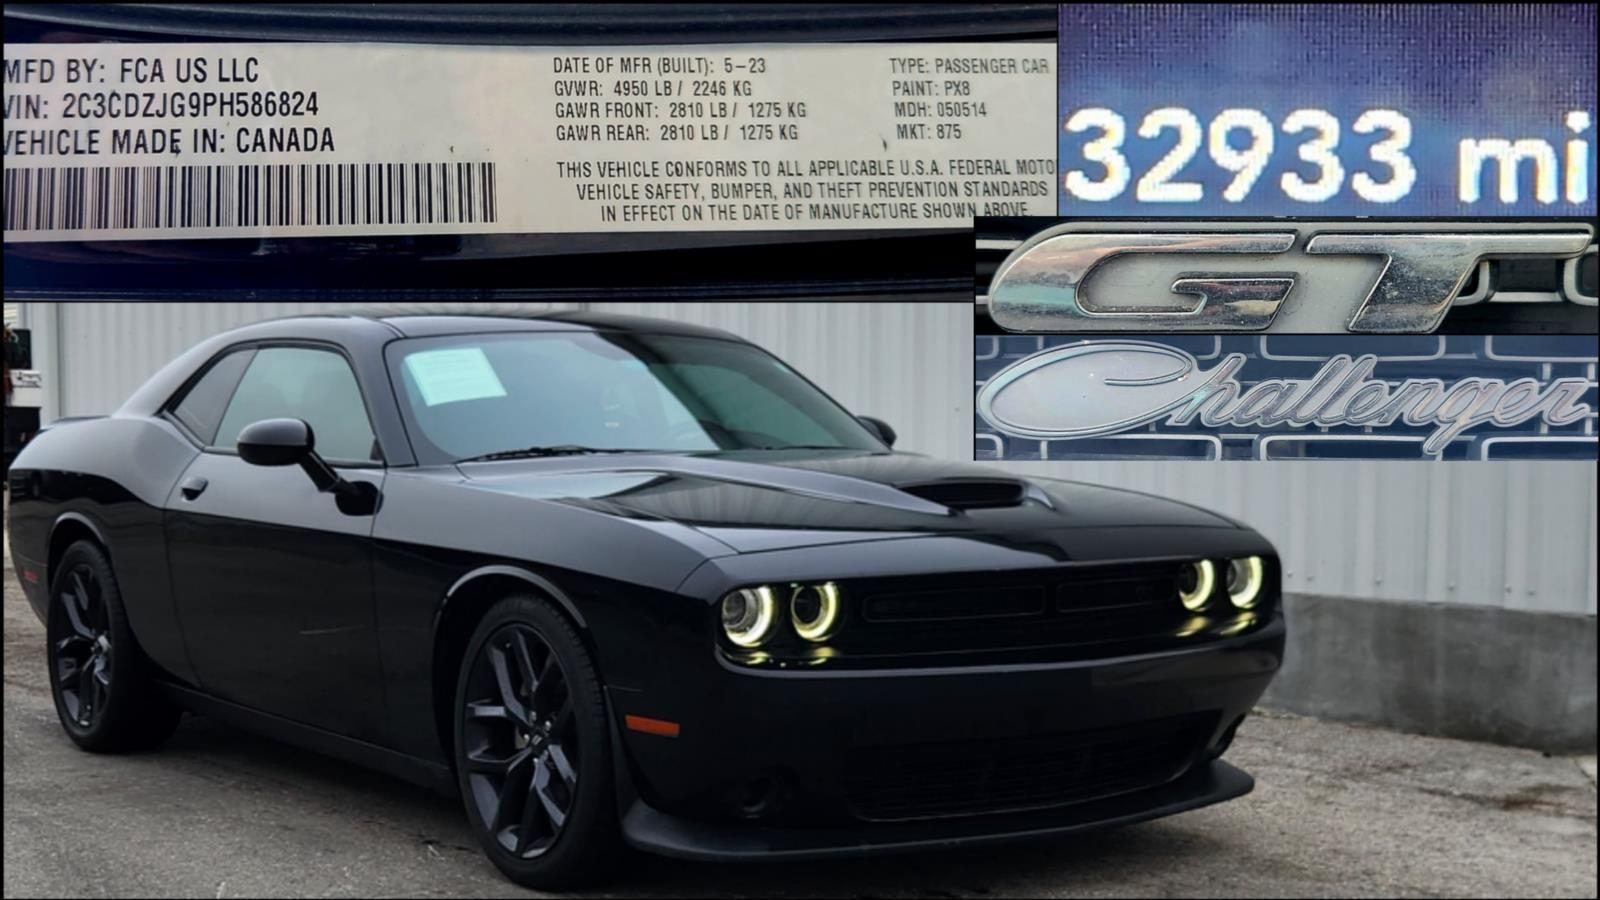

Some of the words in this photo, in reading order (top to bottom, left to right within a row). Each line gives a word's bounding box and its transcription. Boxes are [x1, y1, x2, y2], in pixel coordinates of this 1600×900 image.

[4, 58, 55, 84] MFD
[66, 57, 105, 84] BY:
[120, 57, 165, 84] FCA
[176, 57, 208, 84] US
[218, 56, 259, 83] LLC
[553, 56, 590, 74] DATE
[595, 56, 614, 74] OF
[620, 56, 652, 74] MFR
[657, 56, 715, 77] (BUILT):
[723, 57, 766, 74] 5-23
[888, 57, 930, 74] TYPE:
[934, 57, 1018, 74] PASSENGER
[1021, 58, 1049, 74] CAR
[554, 80, 603, 97] GVWR:
[613, 79, 649, 97] 4950
[654, 80, 673, 97] LB
[677, 79, 683, 97] /
[692, 80, 727, 97] 2246
[732, 80, 752, 97] KG
[892, 80, 939, 97] PAINT:
[943, 80, 971, 97] PX8
[4, 94, 49, 120] VIN:
[62, 90, 319, 119] 2C3CDZJG9PH586824
[555, 101, 600, 119] GAWR
[605, 101, 659, 119] FRONT:
[669, 101, 704, 119] 2810
[709, 101, 728, 118] LB
[731, 101, 738, 119] /
[747, 101, 783, 118] 1275
[787, 101, 807, 118] KG
[893, 101, 932, 118] MDH:
[936, 101, 988, 118] 050514
[4, 128, 101, 156] VEHICLE
[111, 128, 182, 156] MADE
[193, 128, 225, 154] IN:
[236, 127, 335, 154] CANADA
[556, 124, 601, 141] GAWR
[606, 124, 650, 141] REAR:
[660, 124, 695, 141] 2810
[700, 124, 719, 141] LB
[723, 124, 729, 141] /
[739, 123, 774, 141] 1275
[778, 123, 799, 141] KG
[896, 123, 931, 140] MKT:
[936, 123, 962, 140] 875
[1065, 107, 1417, 202] 32933
[1459, 111, 1590, 203] mi
[556, 161, 592, 179] THIS
[596, 160, 660, 178] VEHICLE
[665, 160, 748, 178] CONFORMS
[751, 160, 771, 177] TO
[776, 160, 804, 177] ALL
[808, 159, 895, 177] APPLICABLE
[899, 159, 944, 176] U.S.A.
[948, 159, 1012, 176] FEDERAL
[575, 183, 640, 201] VEHICLE
[644, 182, 705, 201] SAFETY,
[710, 182, 777, 201] BUMPER,
[783, 181, 813, 199] AND
[816, 181, 863, 199] THEFT
[868, 180, 959, 198] PREVENTION
[963, 180, 1049, 198] STANDARDS
[601, 205, 617, 222] IN
[622, 204, 676, 222] EFFECT
[681, 204, 703, 222] ON
[708, 203, 737, 221] THE
[742, 203, 780, 221] DATE
[784, 203, 804, 221] OF
[808, 202, 919, 220] MANUFACTURE
[922, 201, 978, 218] SHOWN
[990, 232, 1592, 332] GT
[979, 340, 1592, 454] Challenger
